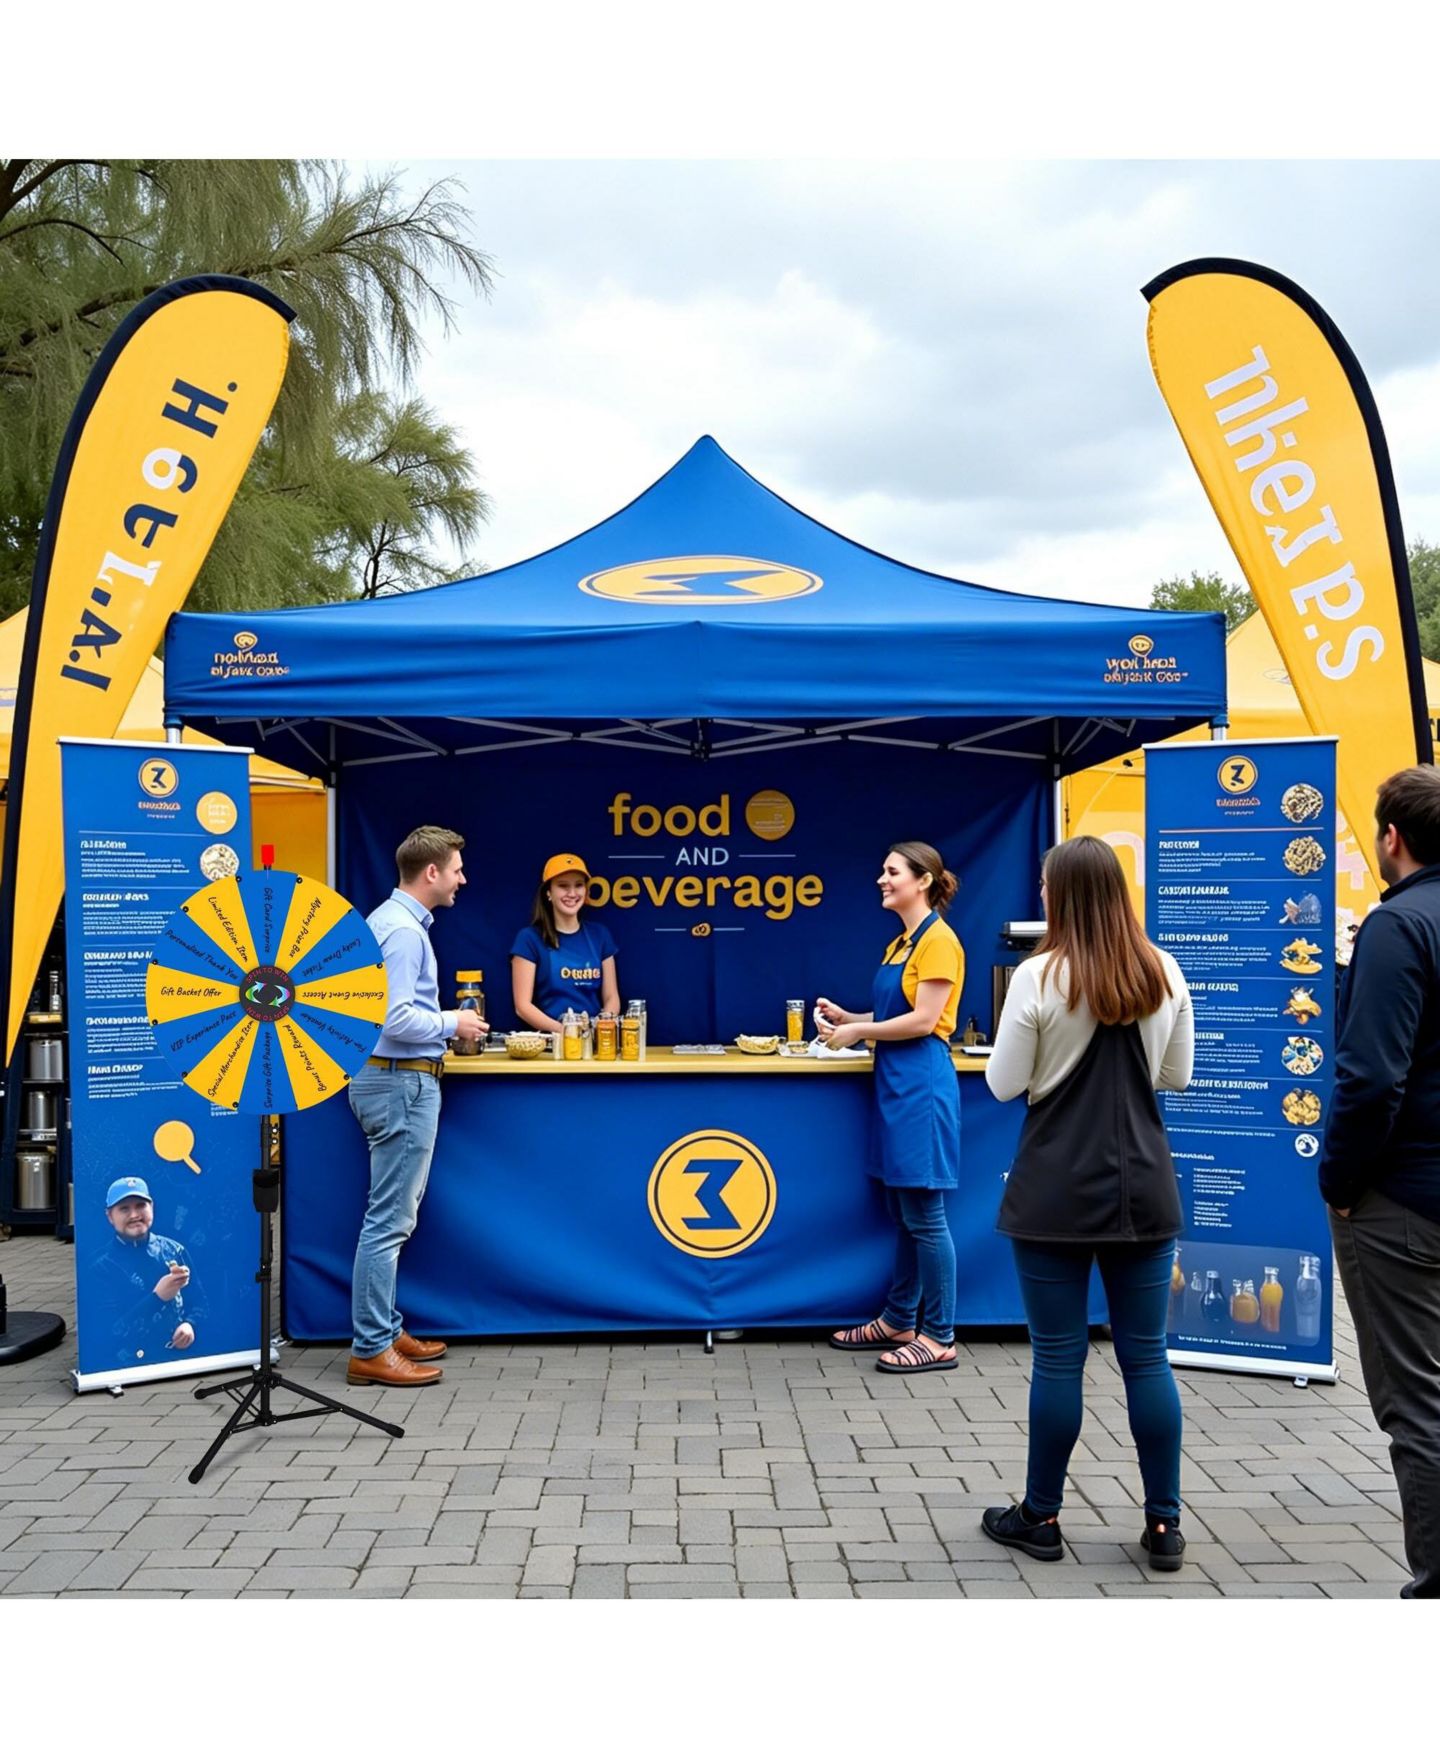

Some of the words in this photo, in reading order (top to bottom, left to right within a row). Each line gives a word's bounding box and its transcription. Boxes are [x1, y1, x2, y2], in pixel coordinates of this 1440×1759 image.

[608, 792, 730, 837] food
[675, 847, 729, 866] AND
[264, 887, 273, 901] Gift
[264, 903, 273, 922] Card
[302, 897, 322, 926] Mystery
[208, 896, 227, 921] Limited
[222, 920, 238, 945] Edition
[236, 945, 248, 963] Item
[264, 923, 273, 953] Surprise
[296, 926, 309, 945] Prize
[289, 944, 300, 958] Box
[342, 938, 361, 949] Lucky
[323, 950, 342, 963] Draw
[204, 954, 224, 972] Thank
[225, 968, 238, 980] You
[302, 961, 324, 977] Ticket
[161, 986, 174, 996] Gift
[176, 986, 201, 996] Basket
[203, 988, 222, 997] Offer
[302, 991, 327, 1000] Access
[329, 991, 350, 1000] Event
[352, 991, 385, 1000] Exclusive
[170, 1038, 186, 1052] VIP
[185, 1021, 220, 1044] Experience
[220, 1010, 237, 1025] Pass
[300, 1012, 327, 1032] Voucher
[282, 1024, 303, 1049] Reward
[207, 1072, 223, 1097] Special
[220, 1035, 245, 1074] Merchandise
[241, 1020, 254, 1037] Item
[299, 1049, 315, 1071] Points
[263, 1060, 273, 1077] Gift
[312, 1071, 327, 1092] Bonus
